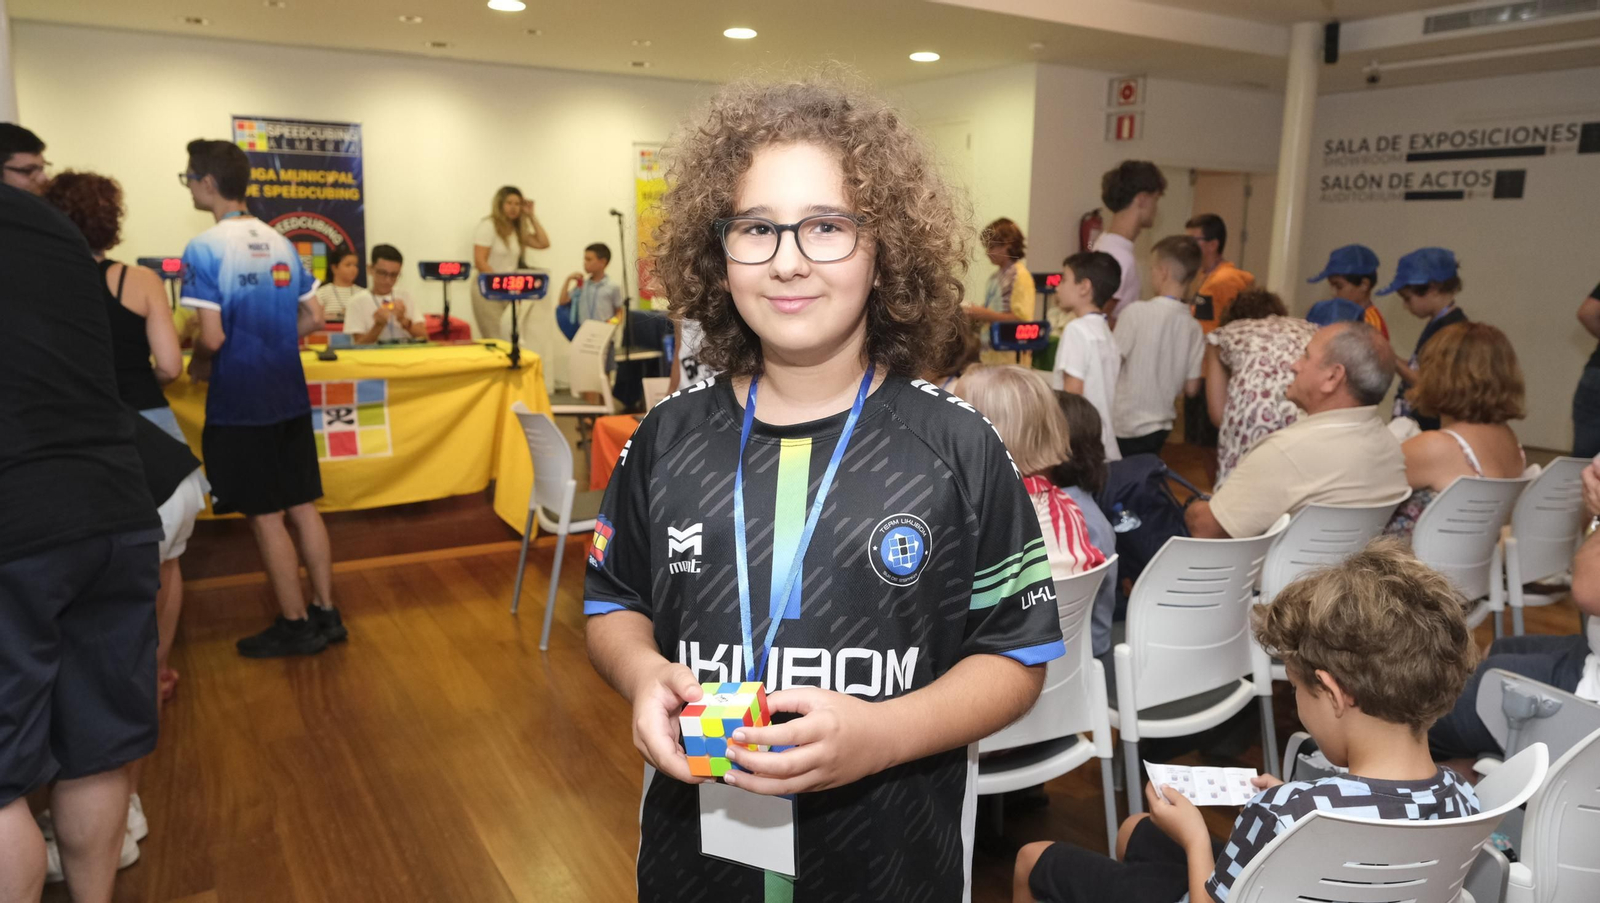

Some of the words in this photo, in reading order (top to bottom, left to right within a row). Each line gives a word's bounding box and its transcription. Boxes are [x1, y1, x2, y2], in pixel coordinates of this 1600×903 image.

[267, 124, 358, 140] SPEEDCUBING
[1324, 138, 1370, 155] SALA
[1375, 135, 1402, 152] DE
[1409, 123, 1578, 149] EXPOSICIONES
[250, 167, 277, 180] IGA
[280, 169, 356, 184] MUNICIPAL
[1320, 170, 1383, 191] SALÓN
[1388, 171, 1415, 189] DE
[1419, 169, 1493, 188] ACTOS
[262, 184, 360, 200] SPEEDCUBING
[275, 216, 344, 246] EEDCUBING
[879, 518, 899, 533] TEAM
[679, 639, 920, 697] KUBOM
